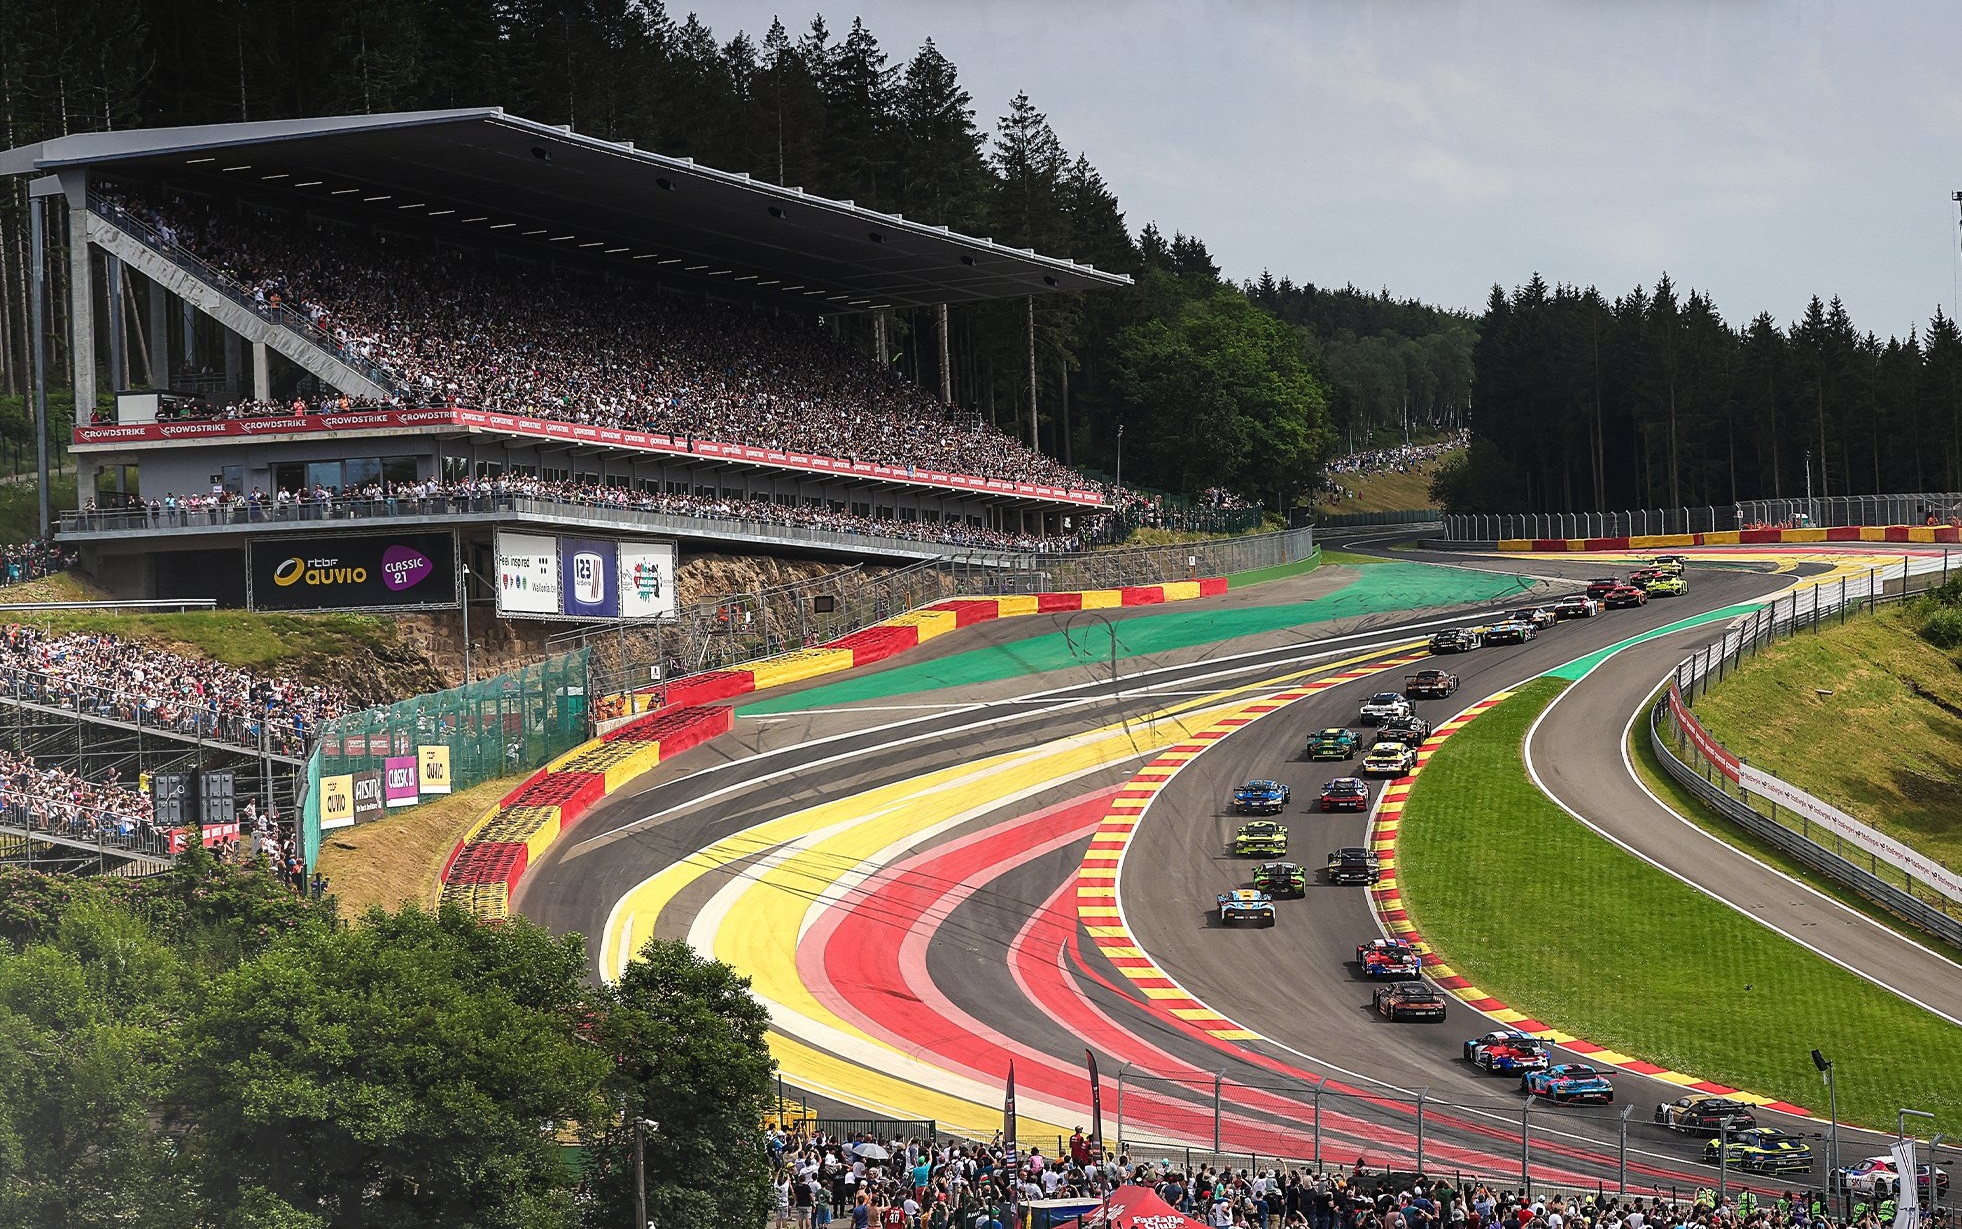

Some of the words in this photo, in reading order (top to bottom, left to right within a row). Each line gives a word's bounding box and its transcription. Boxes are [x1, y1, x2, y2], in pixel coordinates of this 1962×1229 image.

[245, 419, 307, 430] CROWDSTRIKE
[325, 414, 388, 425] CROWDSTRIKE
[84, 427, 146, 438] CROWDSTRIKE
[163, 423, 226, 434] CROWDSTRIKE
[307, 558, 338, 568] rtbf
[384, 557, 424, 573] CLASSIC
[576, 558, 591, 579] 123
[394, 572, 407, 584] 21
[388, 768, 408, 789] CLASSIC
[1132, 1215, 1185, 1225] Farfalle
